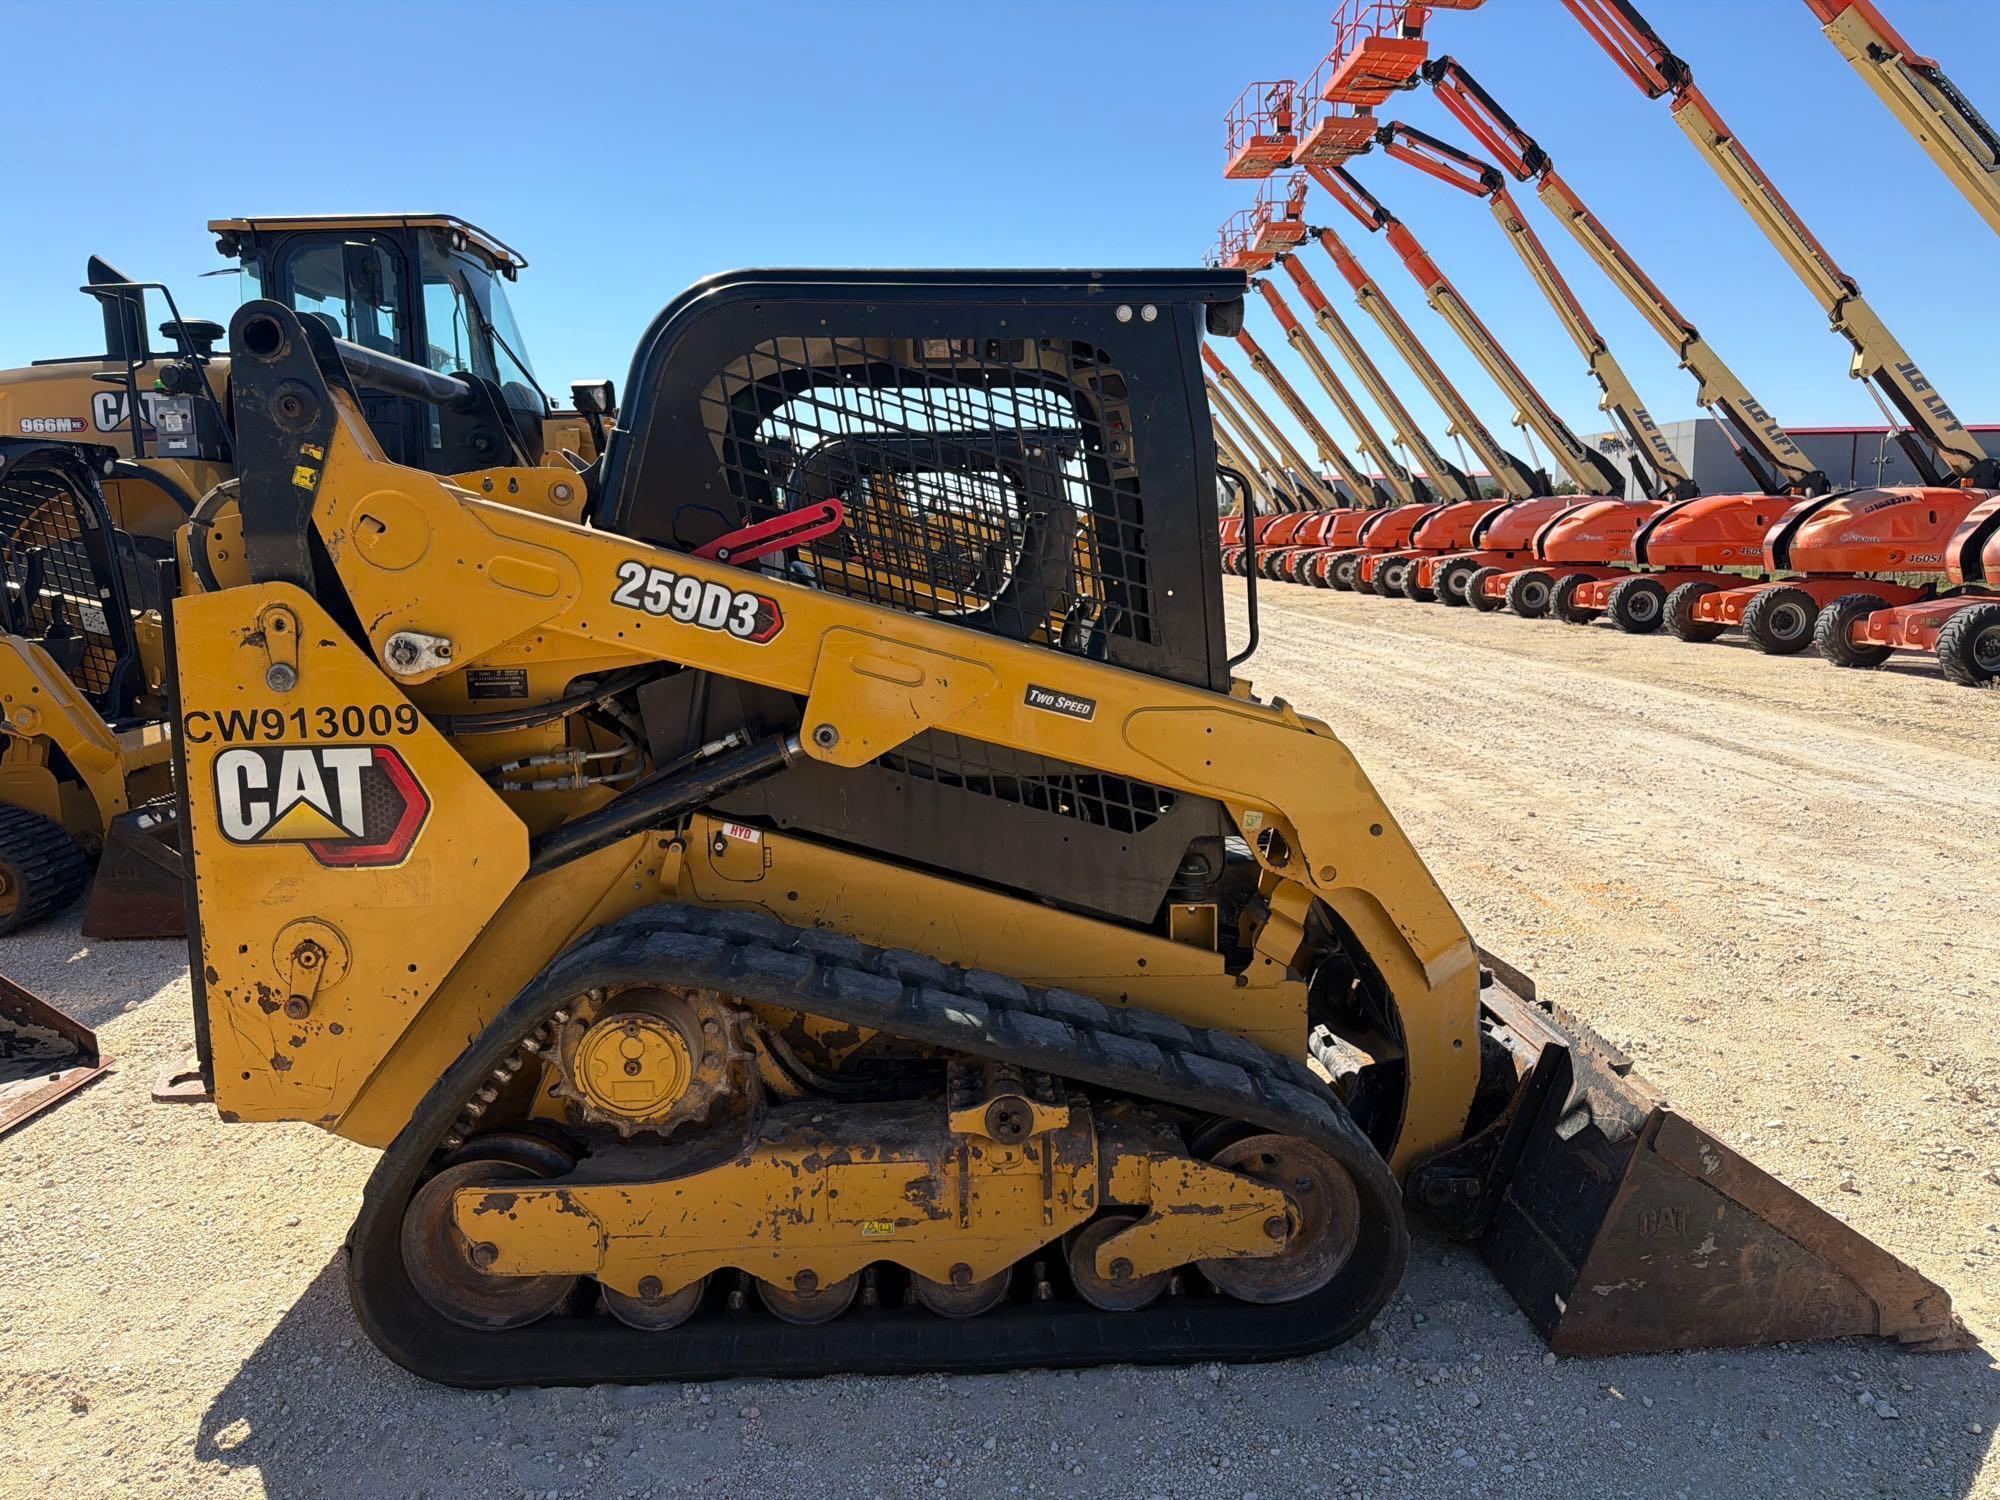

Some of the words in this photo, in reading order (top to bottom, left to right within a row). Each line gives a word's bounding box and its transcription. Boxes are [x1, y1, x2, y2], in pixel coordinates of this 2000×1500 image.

[1894, 362, 1930, 392] JLG
[1922, 395, 1964, 432] LIFT
[20, 418, 72, 433] 966M
[1632, 408, 1657, 431] JLG
[1650, 434, 1677, 462] LIFT
[1738, 398, 1768, 423] JLG
[1764, 424, 1800, 455] LIFT
[1739, 548, 1764, 557] 460S
[1907, 553, 1943, 564] 460SJ
[613, 562, 759, 636] 259D3
[184, 704, 419, 743] CW913009
[216, 748, 373, 841] CAT
[730, 824, 752, 839] HYD
